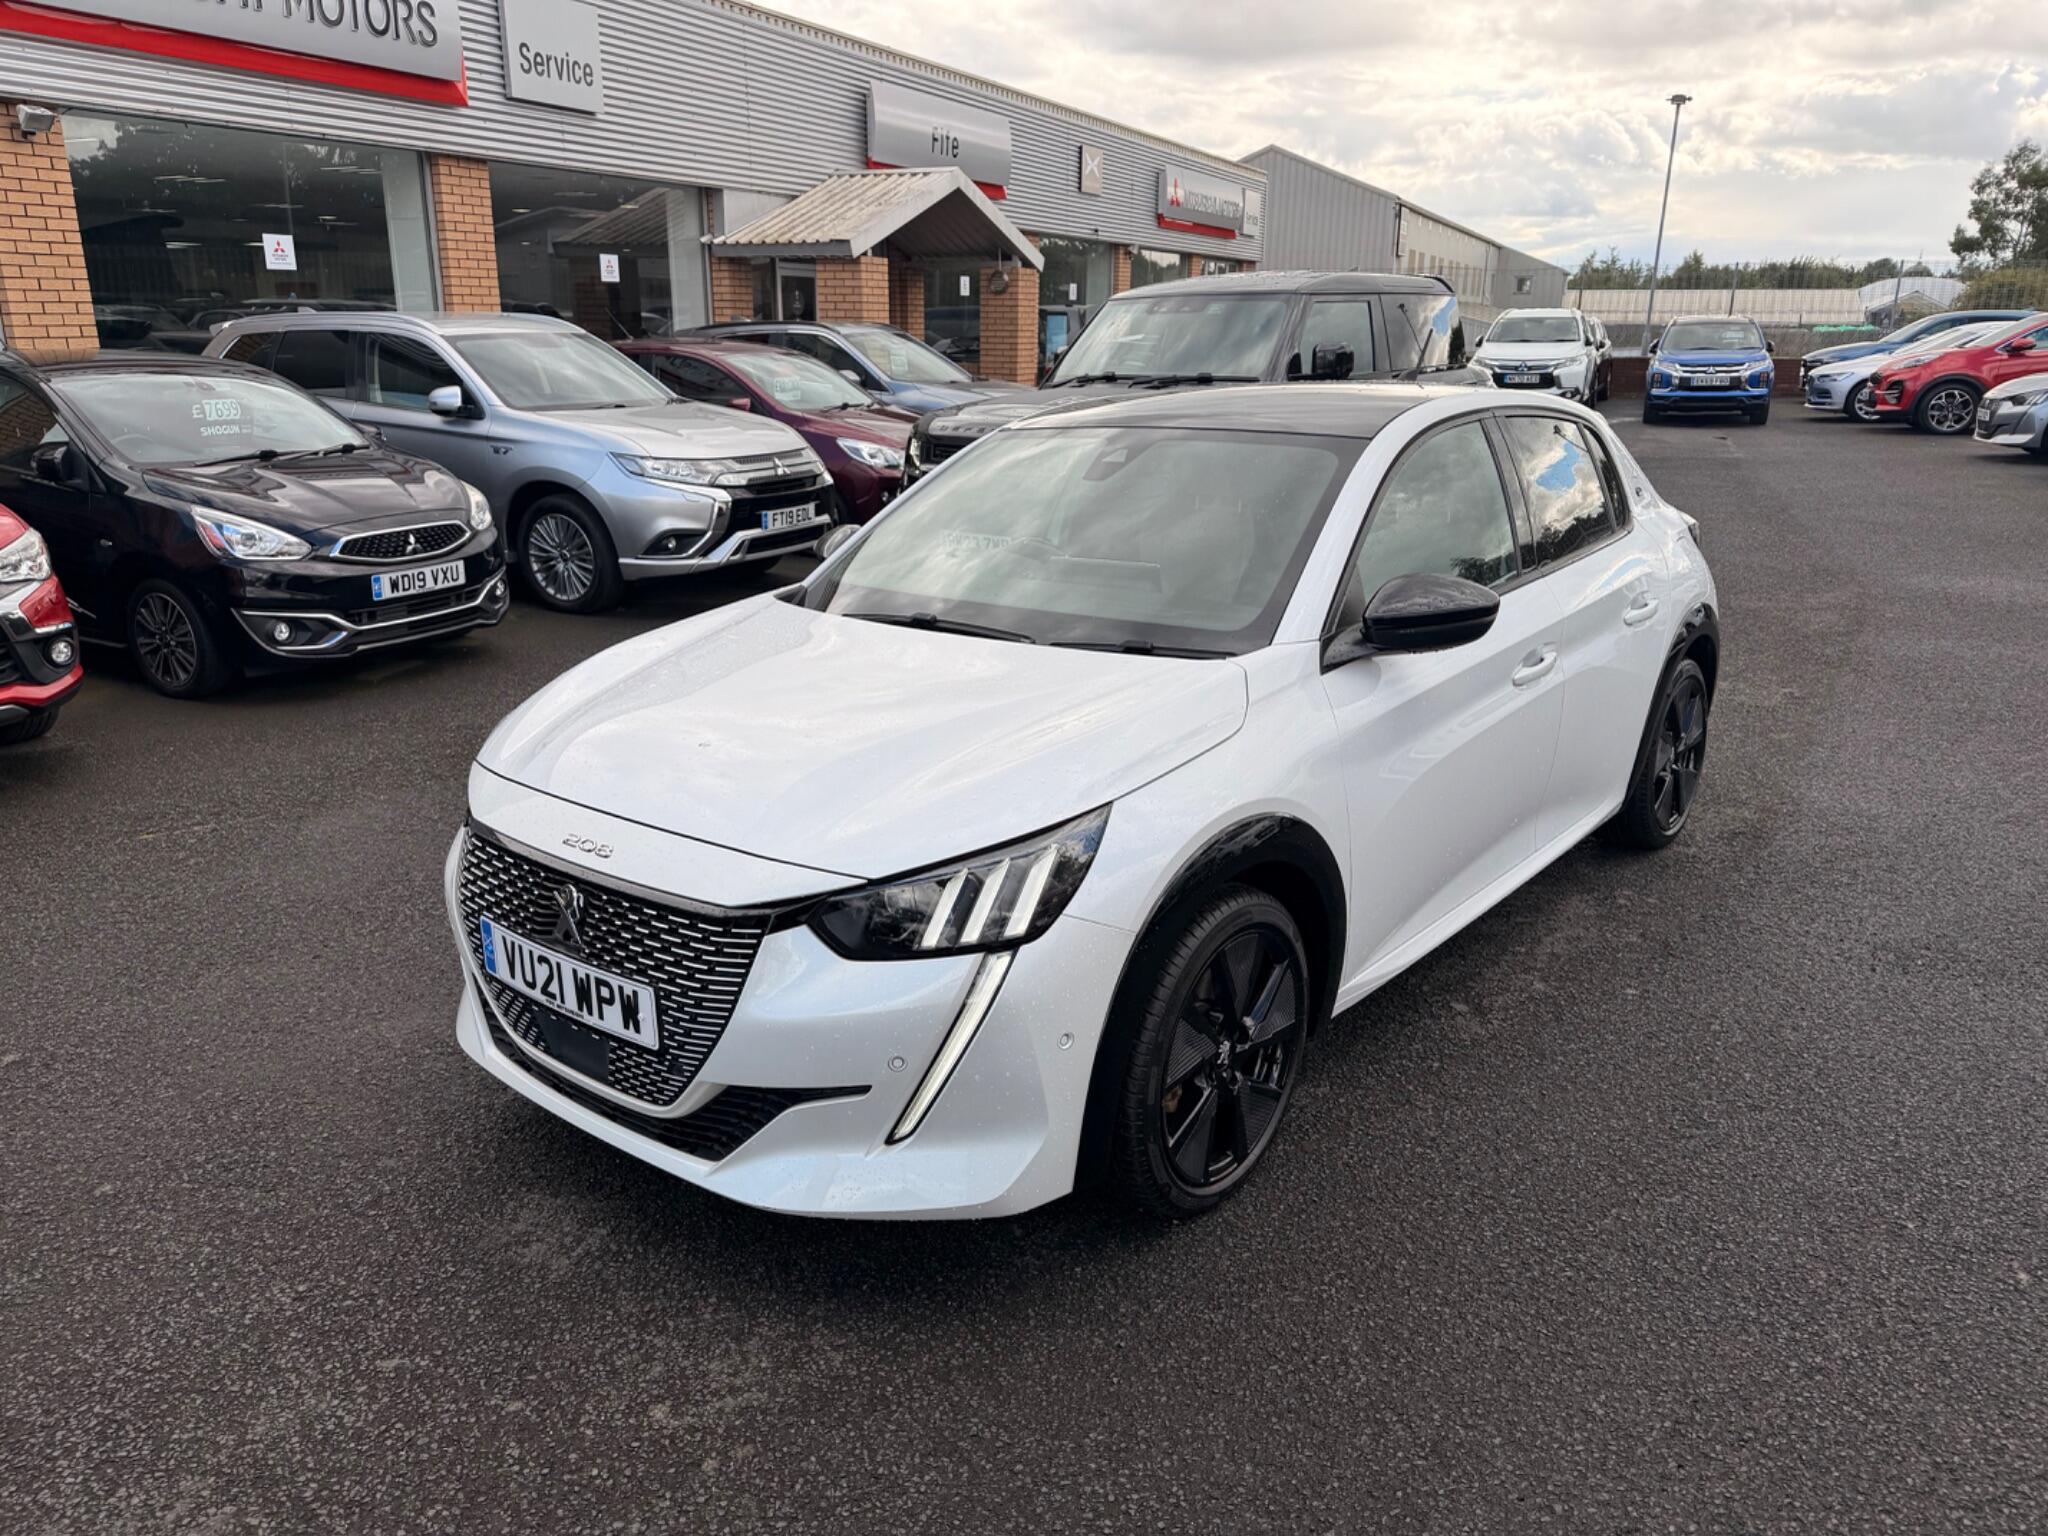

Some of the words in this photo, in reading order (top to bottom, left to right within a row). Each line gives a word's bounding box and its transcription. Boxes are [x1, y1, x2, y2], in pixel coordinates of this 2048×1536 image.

[518, 41, 594, 88] Service
[772, 510, 795, 528] FT19
[389, 570, 427, 595] WD19
[431, 563, 460, 587] VXU
[561, 832, 615, 860] 208
[501, 935, 566, 1005] VU21
[572, 967, 641, 1035] WPW
